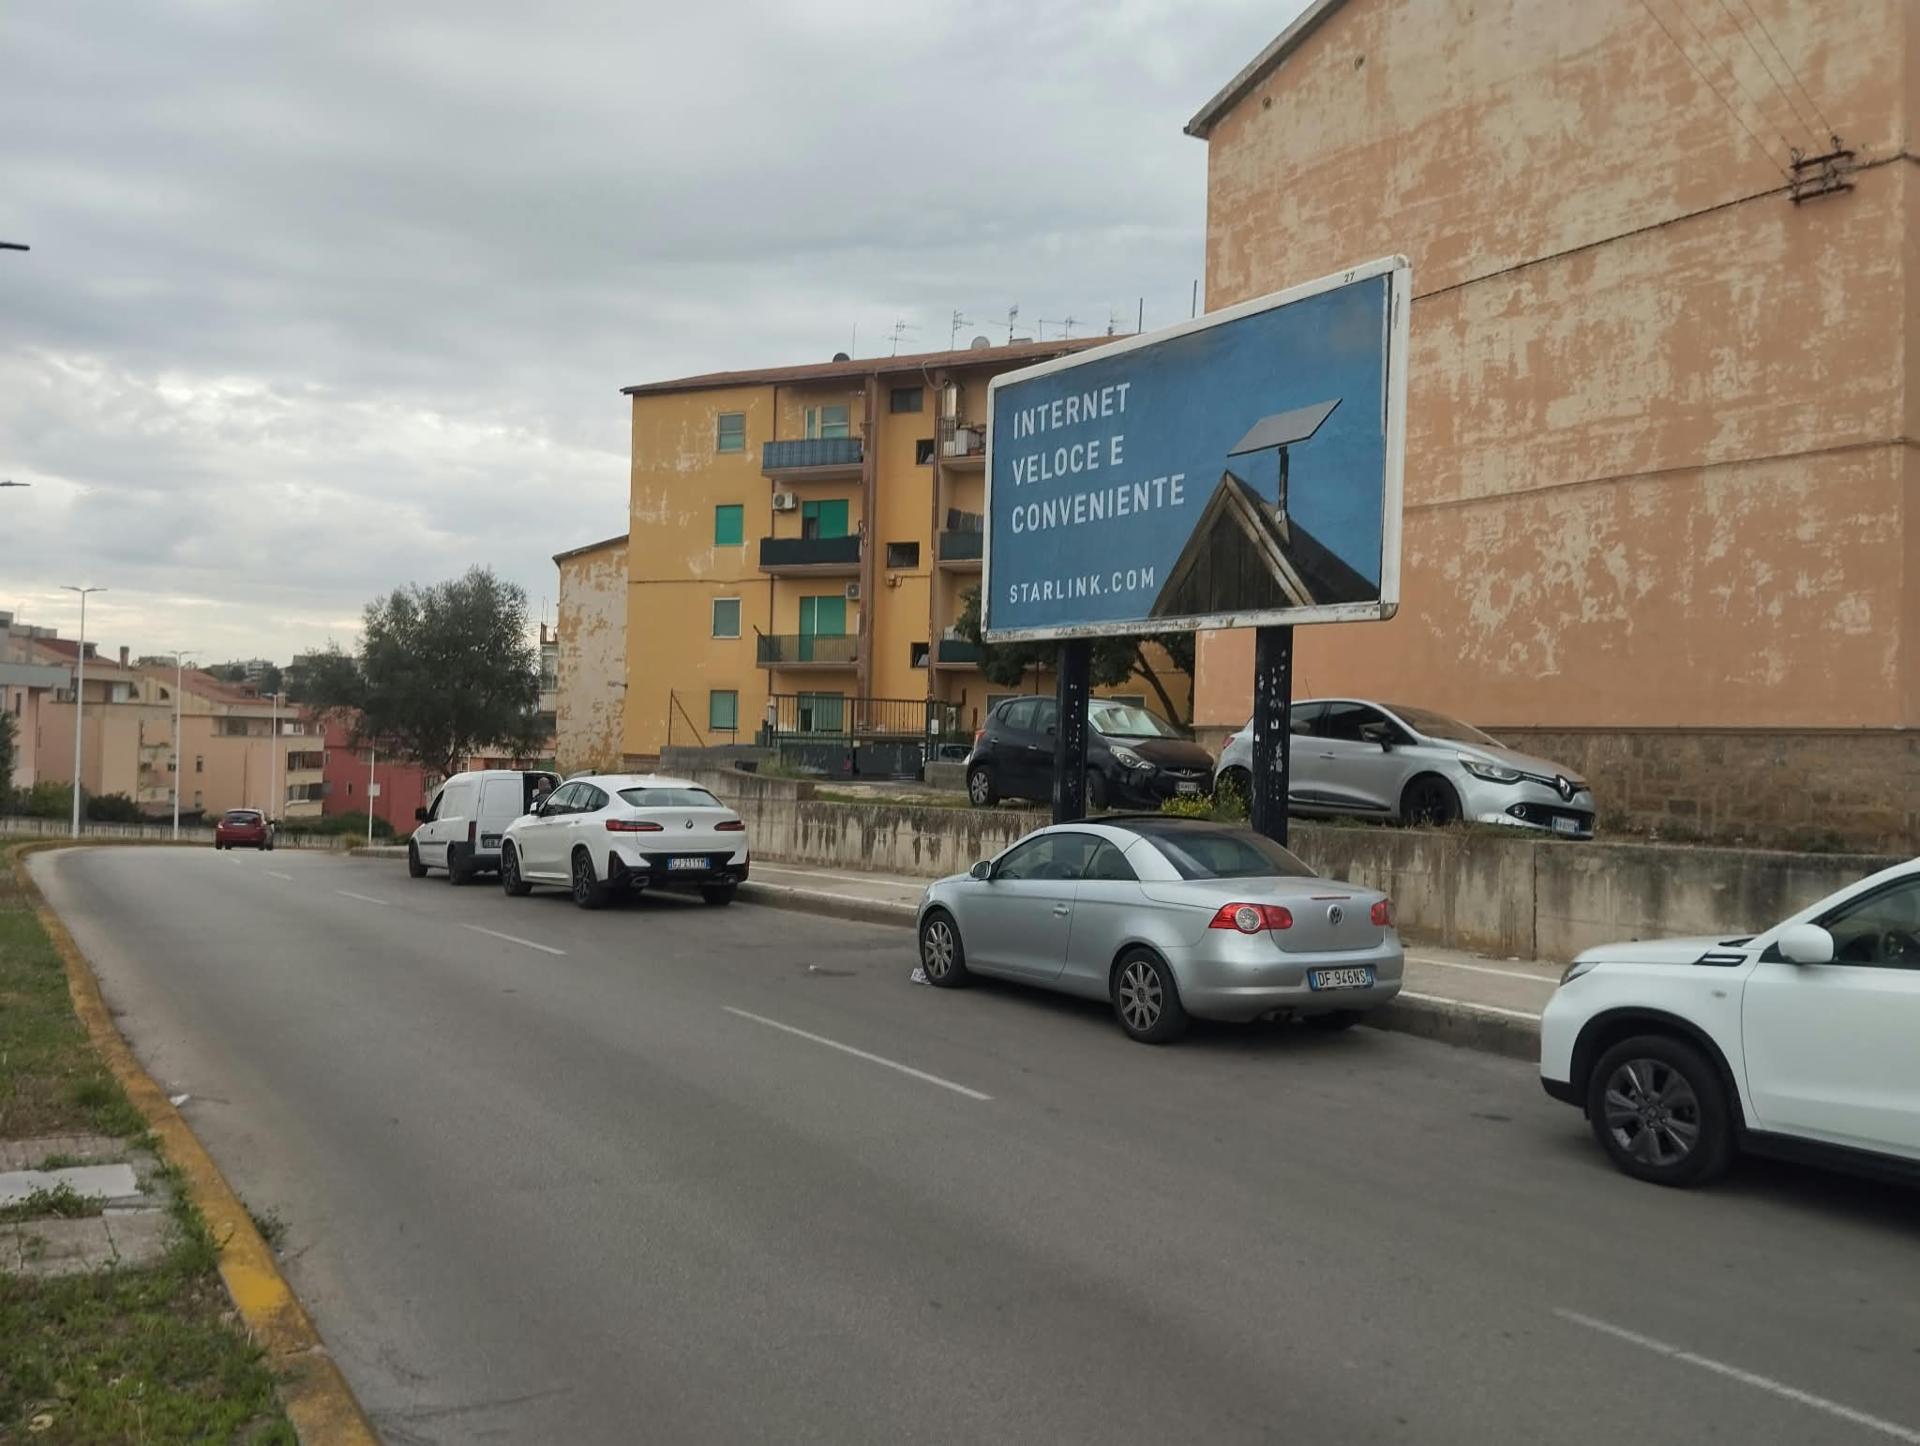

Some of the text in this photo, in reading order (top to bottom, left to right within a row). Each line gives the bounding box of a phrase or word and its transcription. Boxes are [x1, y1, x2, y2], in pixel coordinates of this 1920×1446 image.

[1343, 270, 1356, 283] 27
[1013, 382, 1131, 440] INTERNET
[1012, 434, 1125, 487] VELOCE E
[1011, 473, 1186, 534] CONVENIENTE
[1009, 566, 1155, 604] STARLINK.COM
[1317, 969, 1367, 986] DF 946NS
